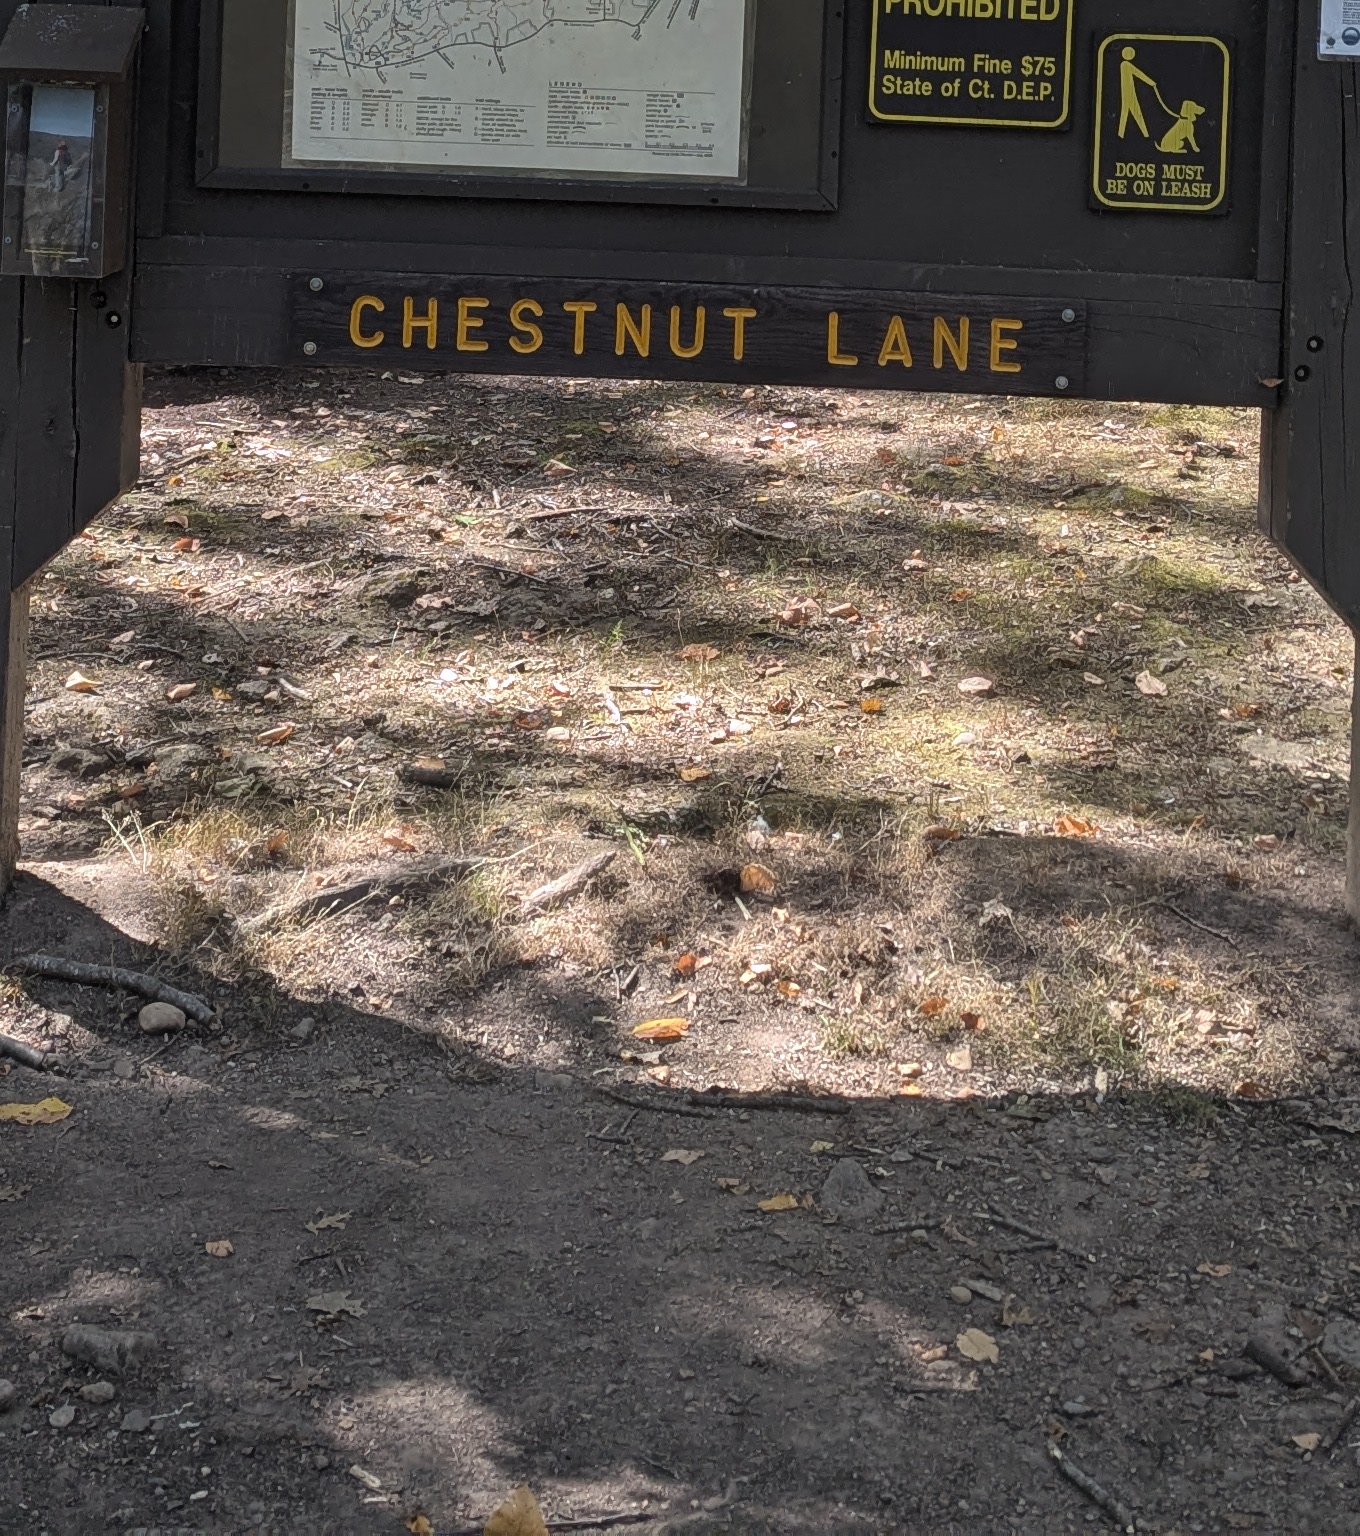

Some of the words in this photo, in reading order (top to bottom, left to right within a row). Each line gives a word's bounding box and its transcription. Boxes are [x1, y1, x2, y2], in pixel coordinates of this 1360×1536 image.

[883, 49, 965, 72] Minimum
[973, 53, 1013, 75] Fine
[1020, 55, 1057, 77] $75
[881, 74, 933, 96] State
[940, 78, 961, 97] of
[968, 78, 995, 99] Ct.
[1003, 80, 1055, 102] D.E.P.
[1114, 162, 1156, 179] DOGS
[1161, 163, 1205, 181] MUST
[1105, 179, 1128, 195] BE
[1132, 180, 1156, 196] ON
[1160, 181, 1213, 198] LEASH
[348, 294, 757, 361] CHESTNUT
[827, 311, 1023, 373] LANE
